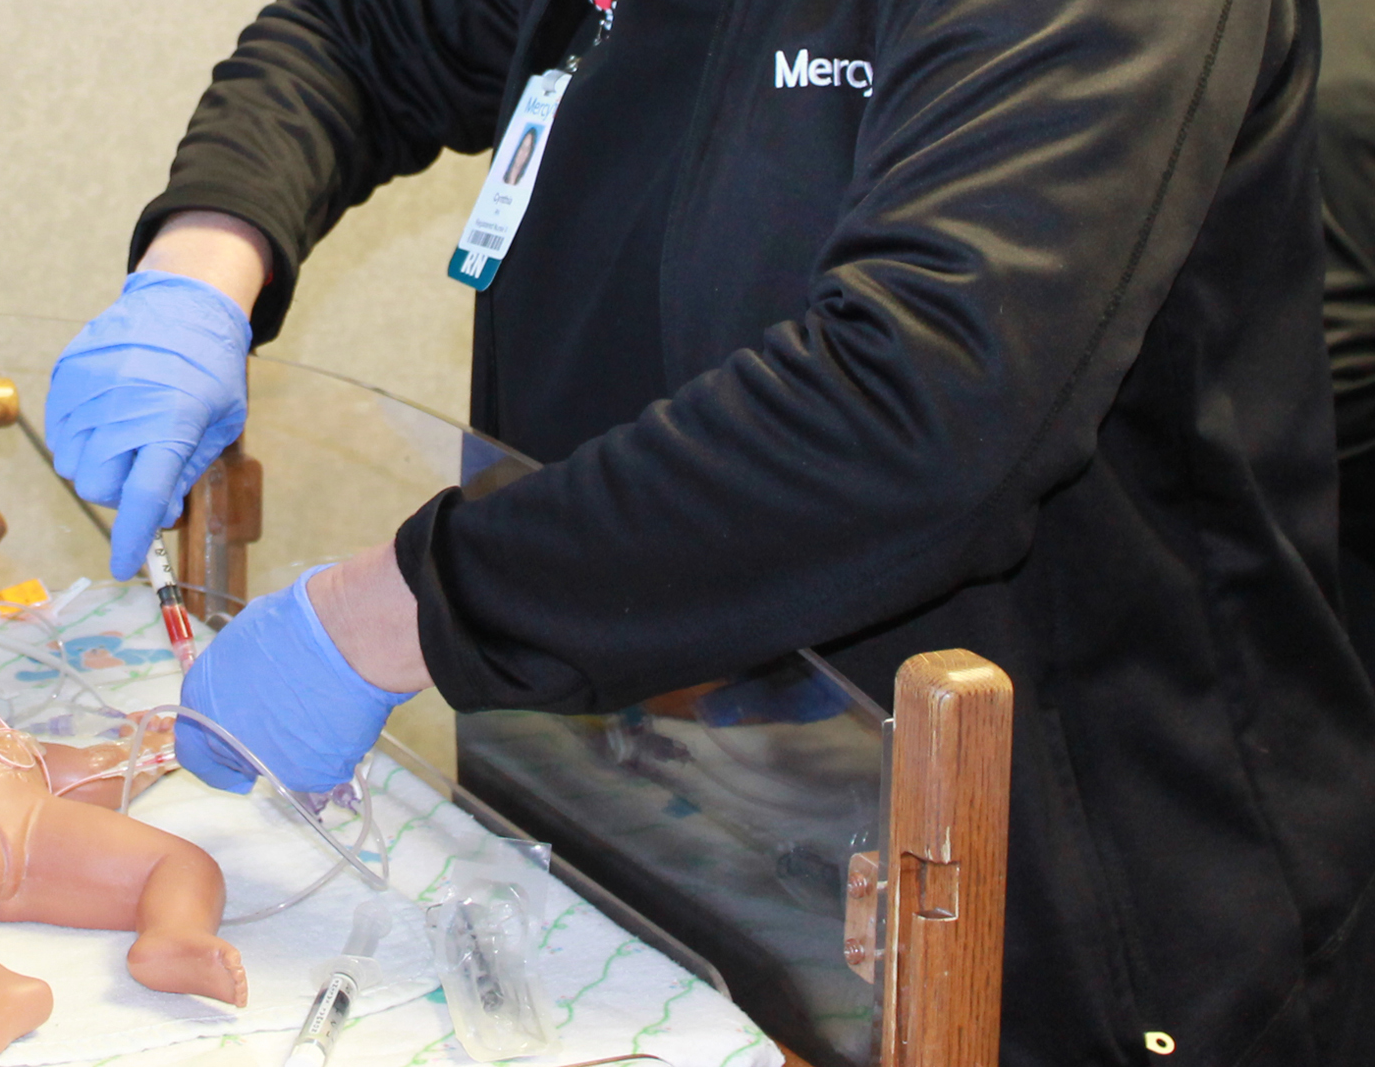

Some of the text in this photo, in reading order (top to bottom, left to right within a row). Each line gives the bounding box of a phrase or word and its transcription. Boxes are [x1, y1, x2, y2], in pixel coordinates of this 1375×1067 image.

[774, 48, 874, 98] Mercy
[524, 97, 552, 121] Mercy
[461, 251, 489, 279] RN
